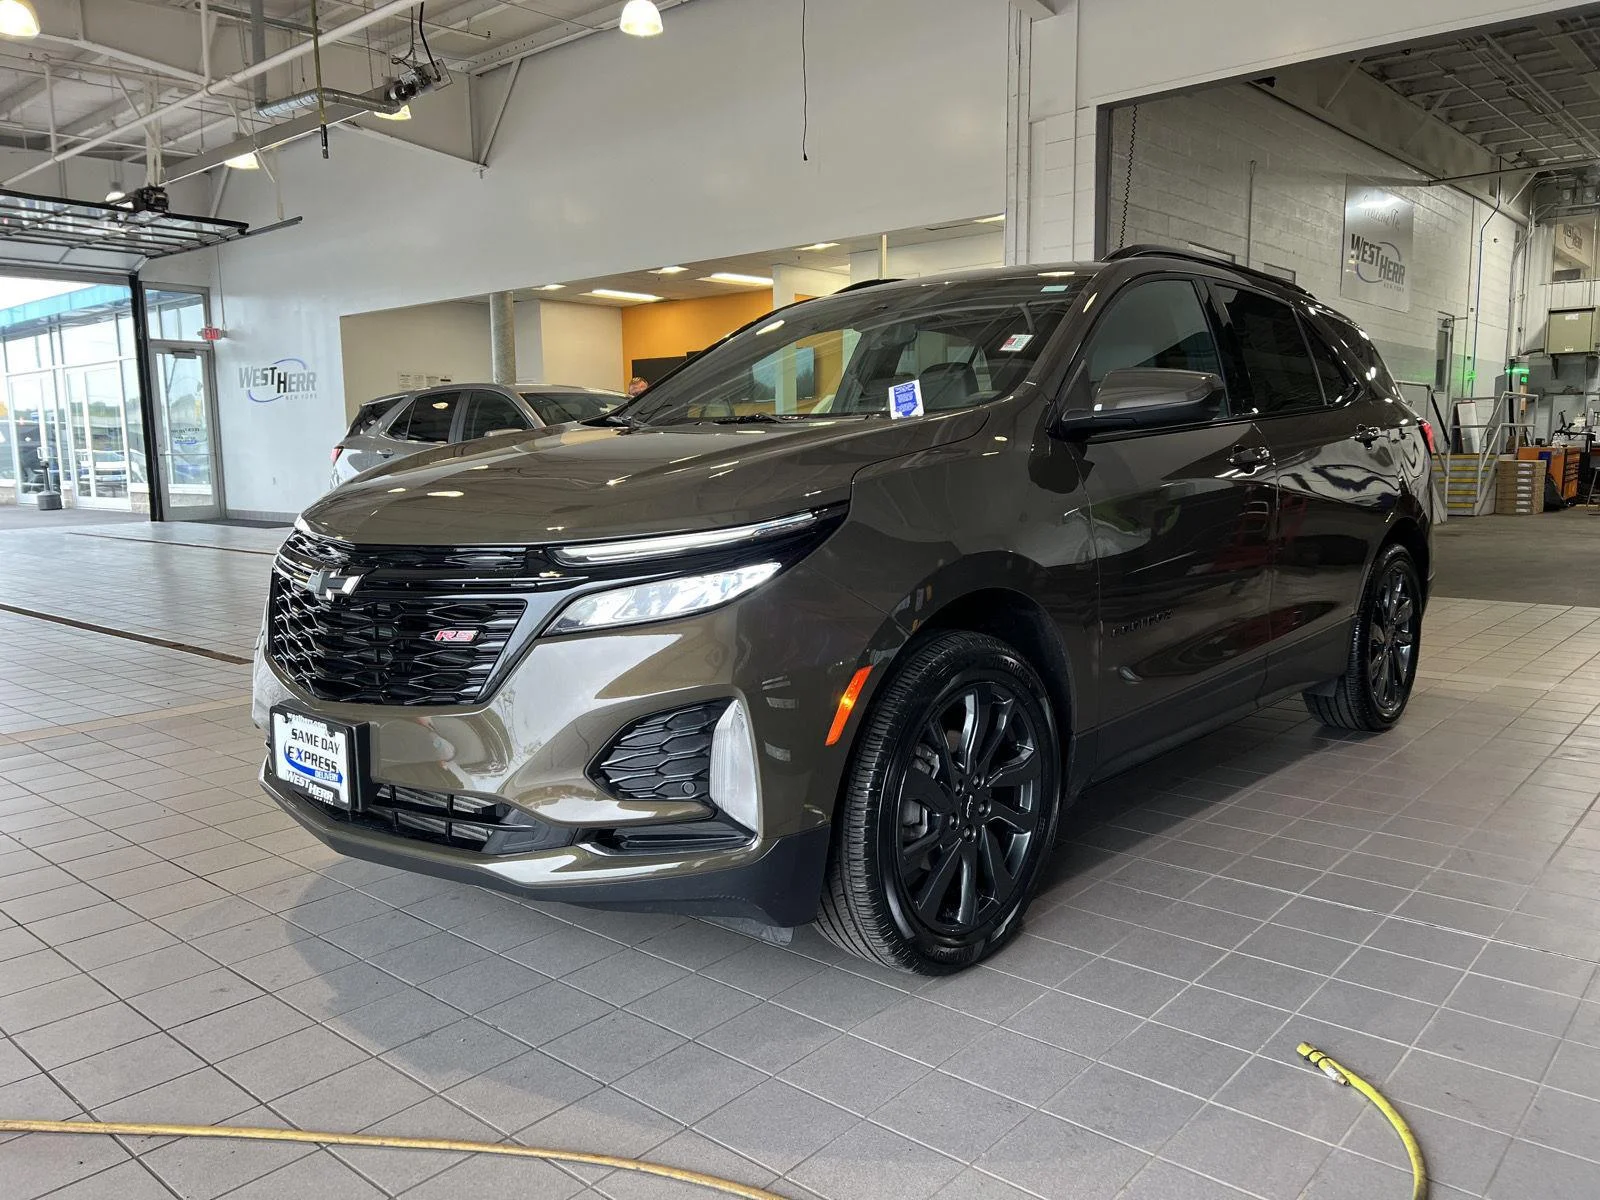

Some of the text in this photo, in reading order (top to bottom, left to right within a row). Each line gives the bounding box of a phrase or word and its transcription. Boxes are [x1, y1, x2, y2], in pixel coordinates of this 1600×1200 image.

[1350, 233, 1405, 285] WEST HERR
[239, 366, 317, 394] WEST HERR
[434, 629, 477, 642] RS
[291, 727, 340, 756] SAME DAY
[287, 745, 338, 774] EXPRESS
[286, 770, 334, 800] WEST HERR
